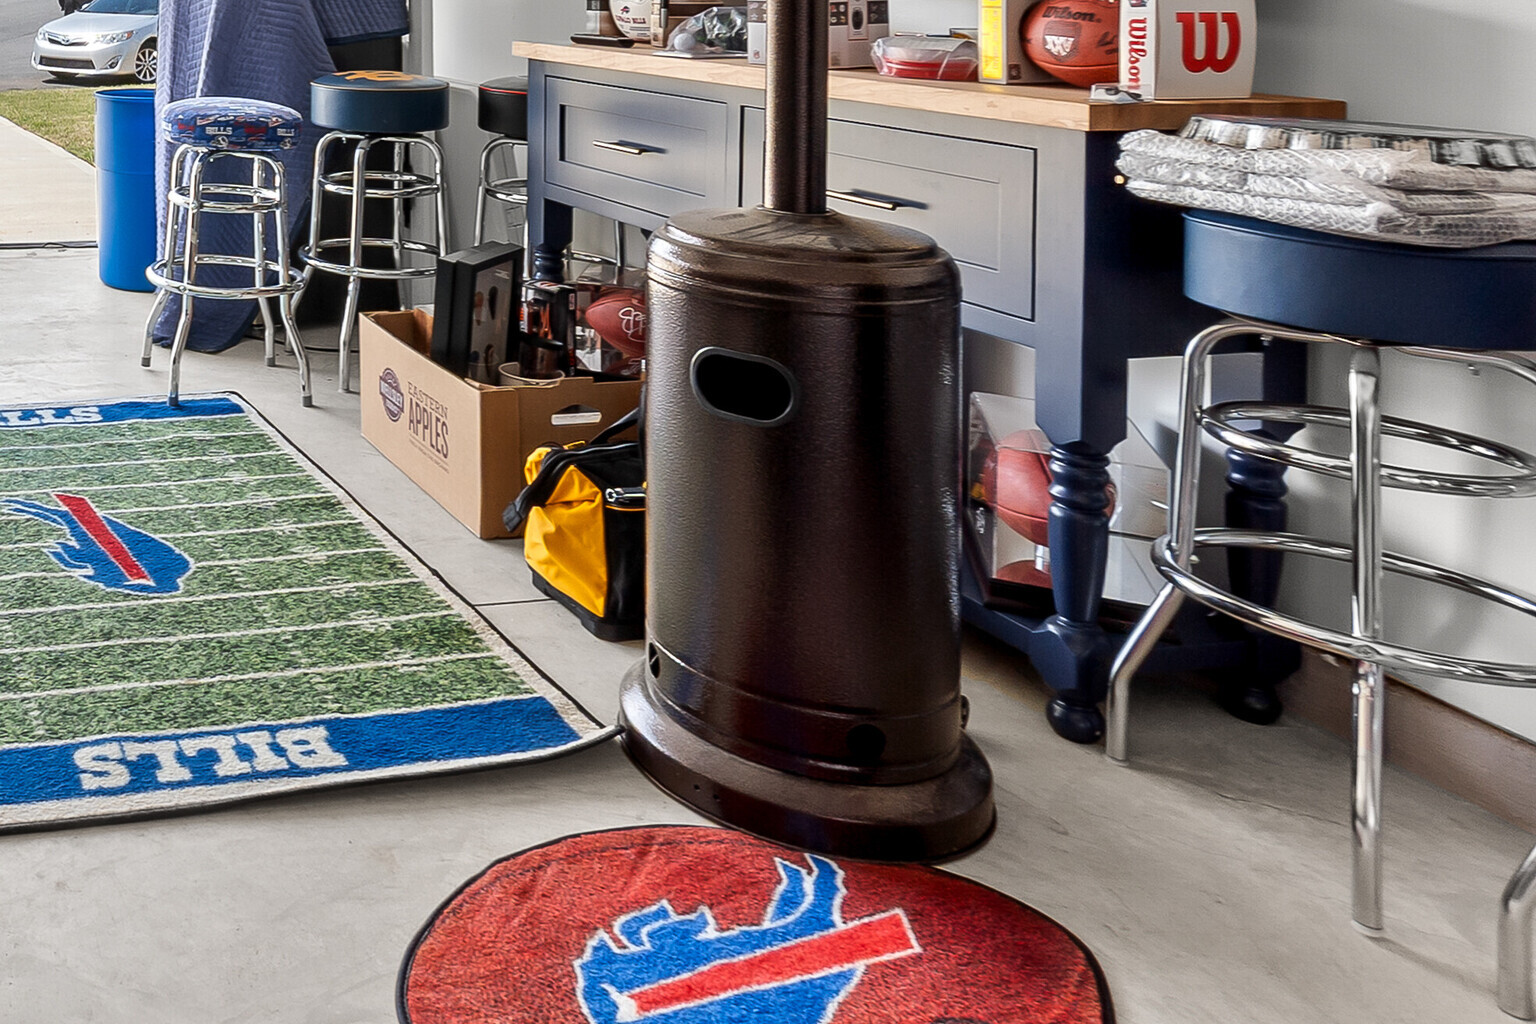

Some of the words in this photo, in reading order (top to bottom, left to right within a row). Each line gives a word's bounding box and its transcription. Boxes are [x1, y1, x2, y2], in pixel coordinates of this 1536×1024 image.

[1043, 6, 1096, 23] Wilson
[1128, 17, 1148, 90] Wilson
[205, 126, 233, 136] BILLS
[407, 381, 449, 419] EASTERN
[408, 397, 449, 459] APPLES
[72, 725, 349, 791] BILLS
